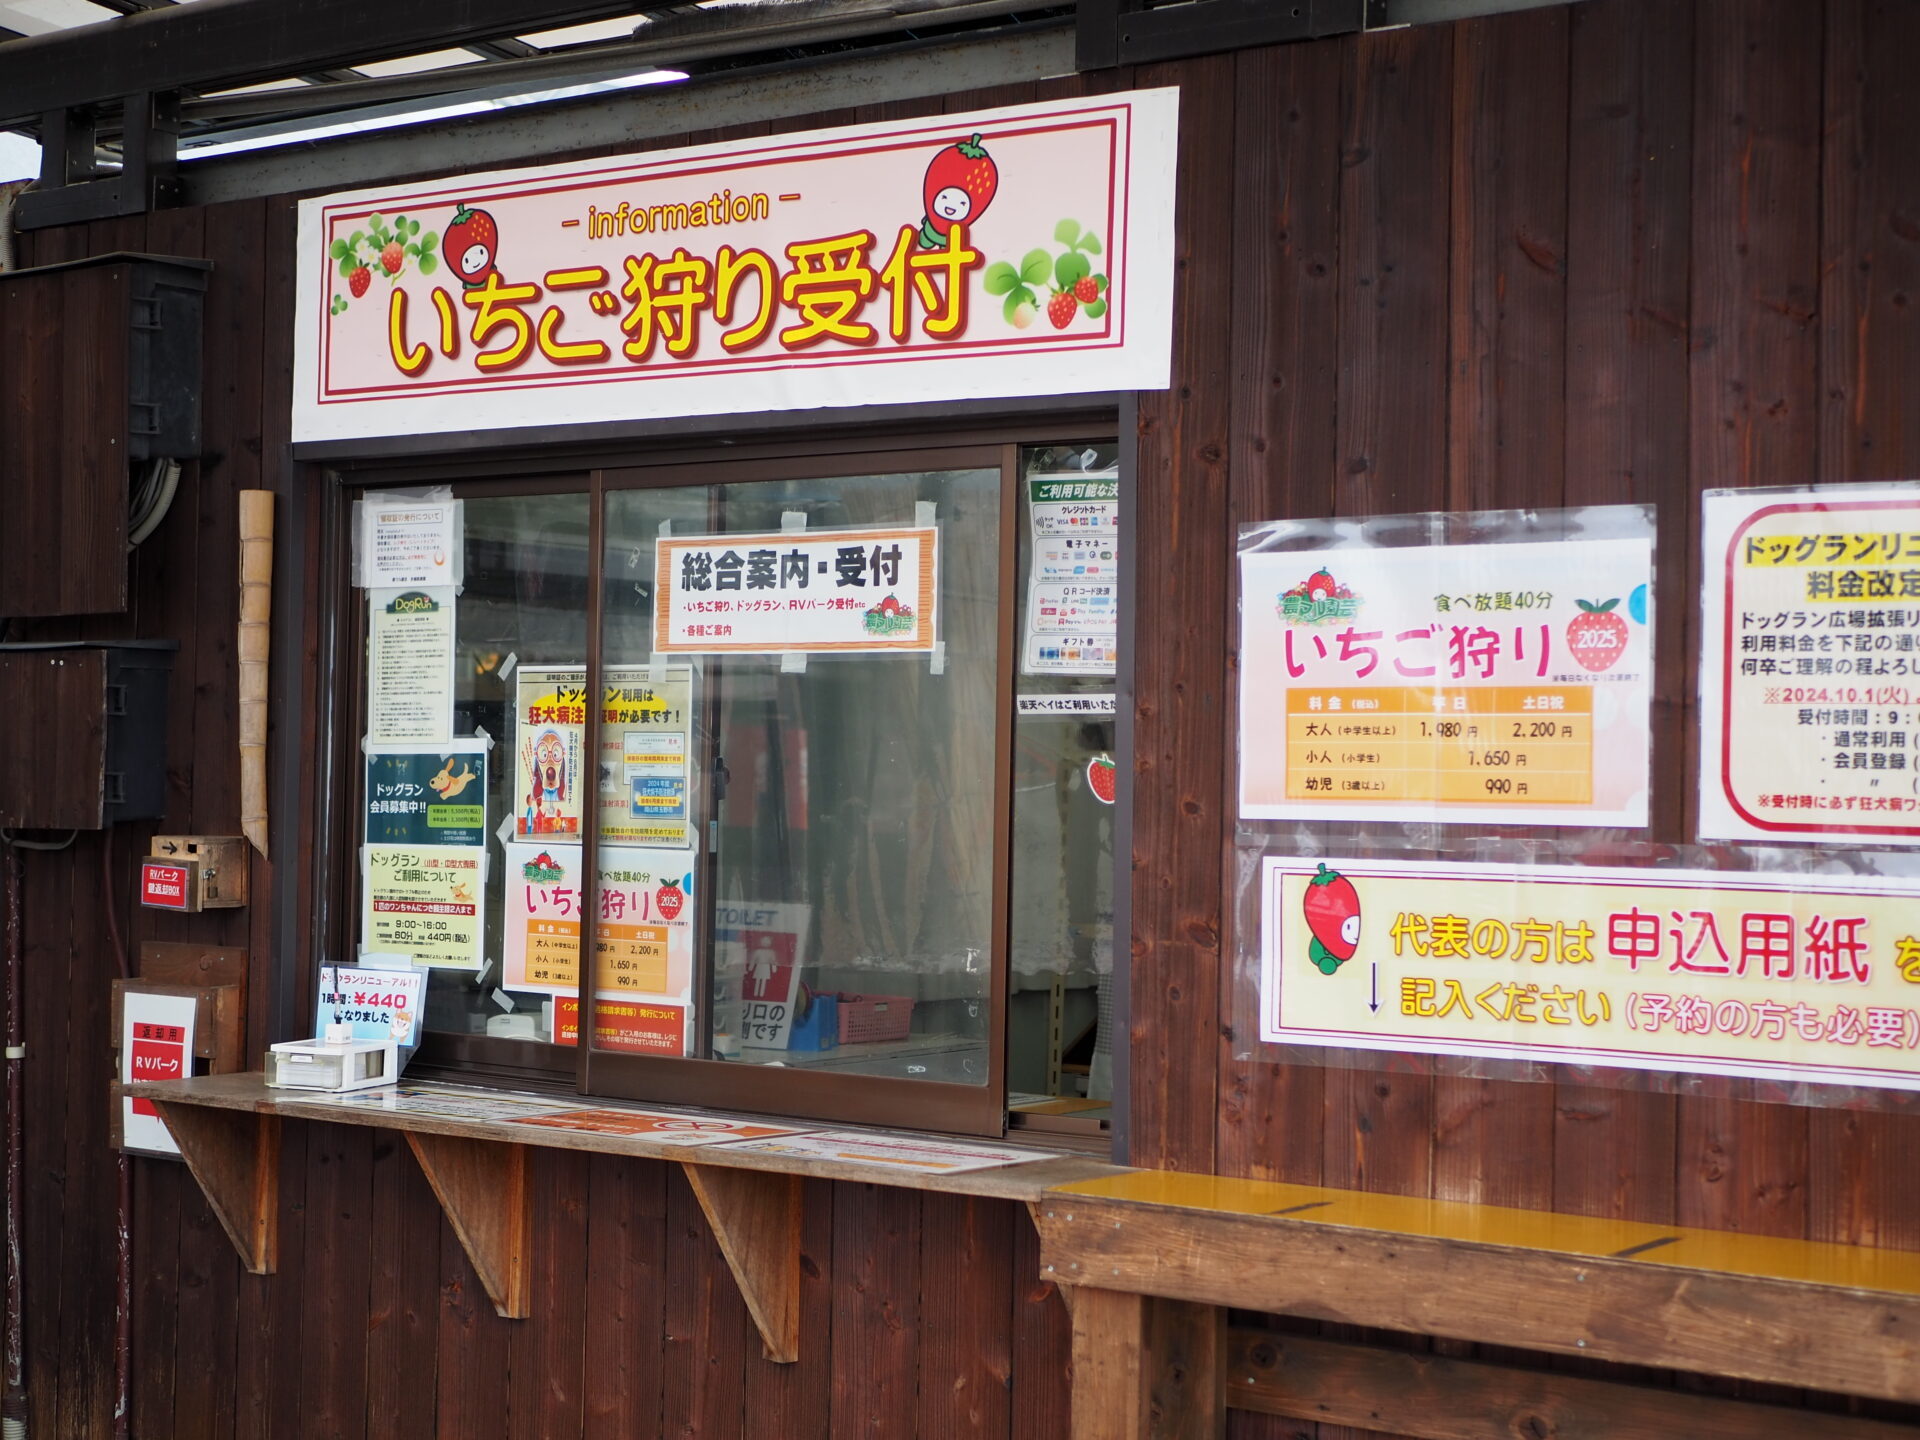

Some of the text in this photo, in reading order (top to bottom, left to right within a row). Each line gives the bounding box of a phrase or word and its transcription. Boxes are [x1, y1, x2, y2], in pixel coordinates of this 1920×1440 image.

[588, 188, 768, 238] information
[388, 223, 977, 375] いちご狩り受付
[681, 544, 902, 591] 総合案内・受付
[1434, 590, 1554, 612] 食べ放題40分
[1577, 629, 1618, 649] 2025
[1284, 623, 1550, 680] いちご狩り
[376, 782, 424, 797] ドッグラン
[1758, 794, 1920, 811] ※受付時に必ず狂犬病ワ
[371, 853, 420, 867] ドッグラン
[394, 869, 456, 883] ご利用について
[1400, 977, 1611, 1027] 記入ください
[136, 1056, 178, 1072] RVパーク
